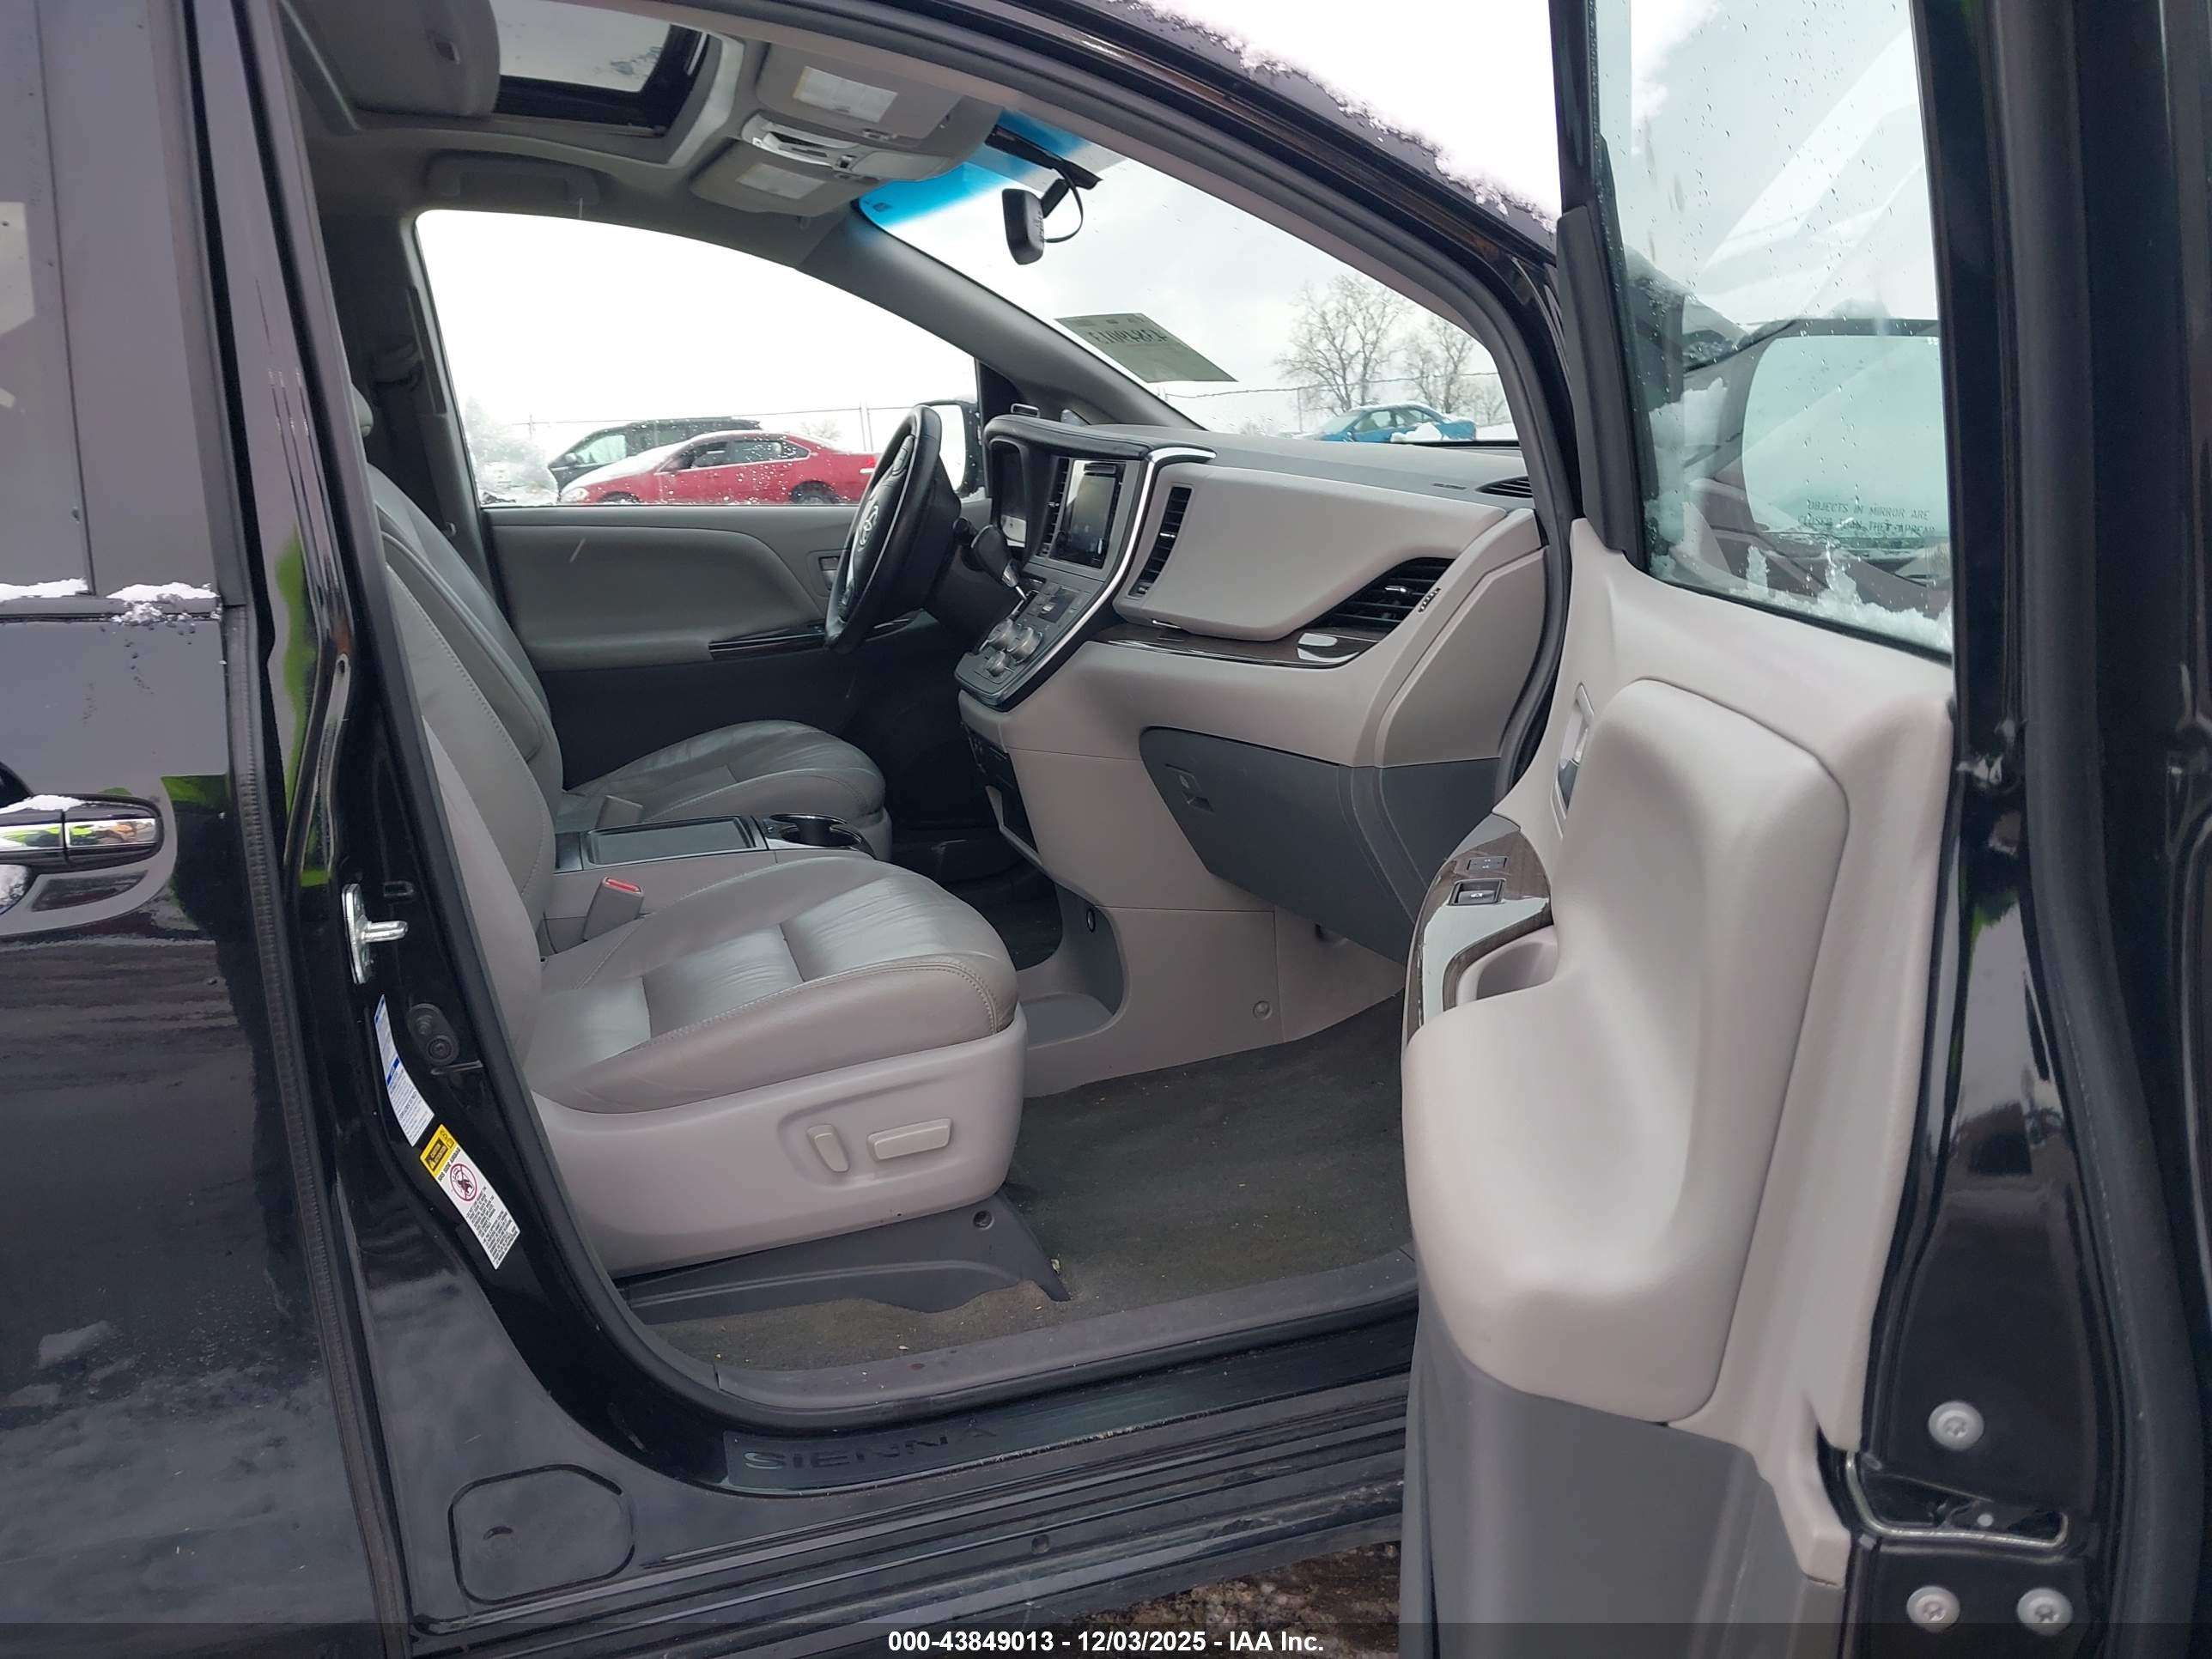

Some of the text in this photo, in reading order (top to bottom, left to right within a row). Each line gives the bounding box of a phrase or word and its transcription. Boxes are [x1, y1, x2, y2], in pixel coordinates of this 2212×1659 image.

[1854, 504, 1863, 514] IN
[1869, 507, 1905, 519] MIRROR
[1911, 508, 1930, 520] ARE
